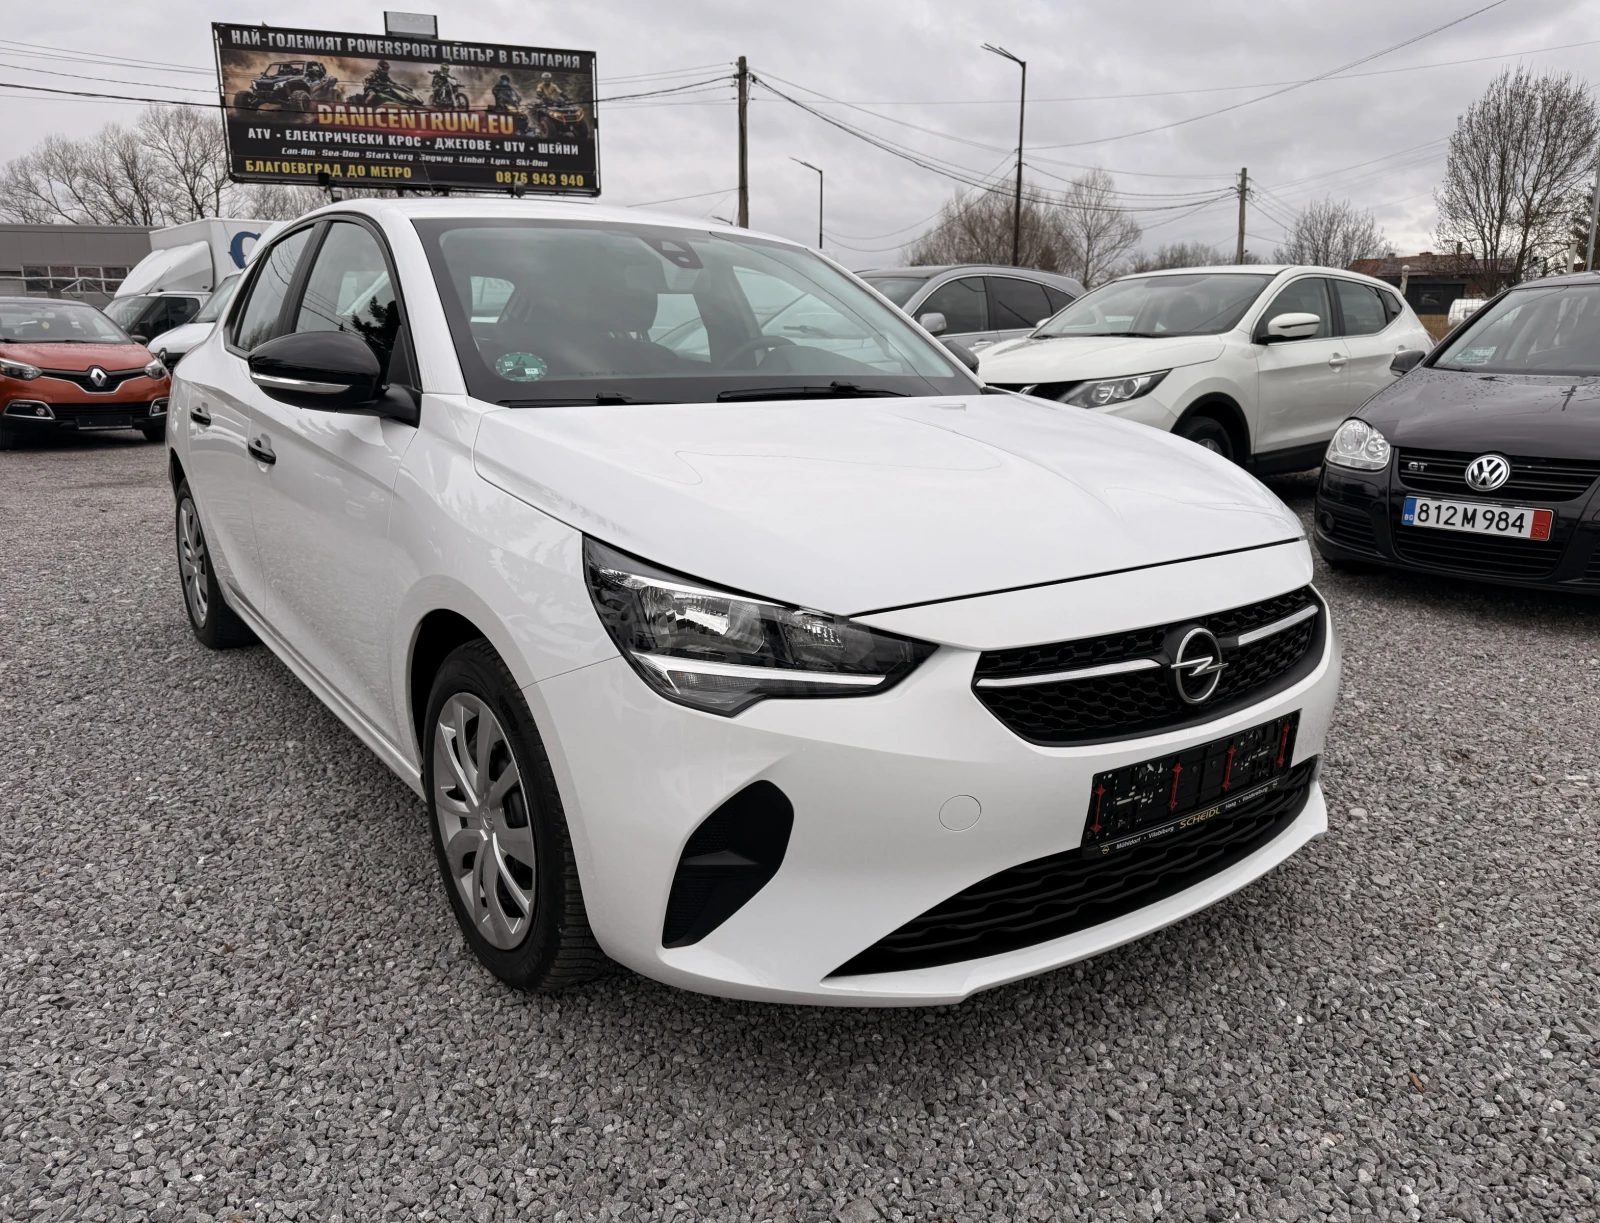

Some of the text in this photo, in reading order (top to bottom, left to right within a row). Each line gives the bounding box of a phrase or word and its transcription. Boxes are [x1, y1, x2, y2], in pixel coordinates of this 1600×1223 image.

[230, 28, 581, 69] НАЙ-ГОЛЕМИЯТ POWERSPORT ЦЕНТЪР В БЪЛГАРИЯ
[317, 103, 514, 135] DANICENTRUM.EU
[248, 128, 579, 156] ATV ЕЛЕКТРИЧЕСКИ КРОС ДЖЕТОВЕ UTV ШЕЙНИ
[281, 147, 549, 168] Can-Am Sea-Doo Stark Varg Segway Linhai Lynx Ski-Doo
[245, 160, 412, 179] БЛАГОЕВГРАД ДО МЕТРО
[495, 170, 584, 187] 0876 943 940
[1407, 461, 1428, 472] GT
[1404, 513, 1414, 521] BG
[1179, 807, 1221, 829] SCHEIDL
